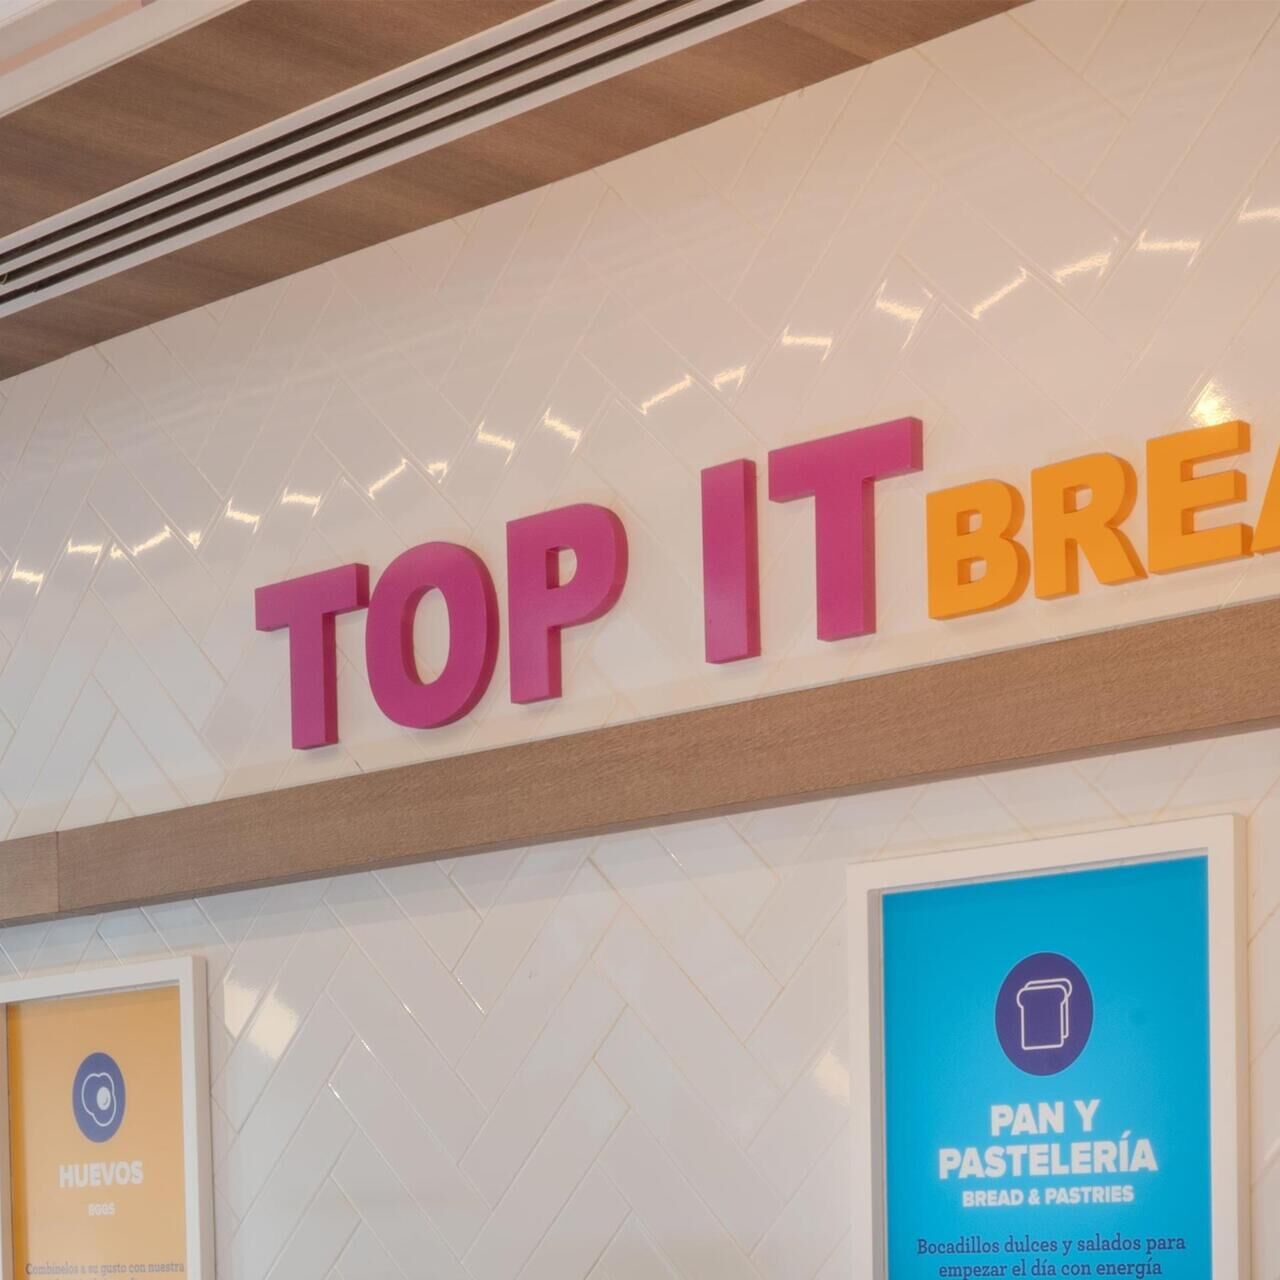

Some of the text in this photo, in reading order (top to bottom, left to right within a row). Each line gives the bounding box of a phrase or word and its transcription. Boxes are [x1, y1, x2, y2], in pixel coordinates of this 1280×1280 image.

[254, 503, 629, 750] TOP
[700, 416, 924, 665] IT
[991, 1099, 1101, 1137] PAN Y
[938, 1131, 1159, 1180] PASTELERÍA
[59, 1160, 144, 1188] HUEVOS
[962, 1185, 1135, 1207] BREAD & PASTRIES
[88, 1202, 115, 1216] EGGS
[917, 1233, 1186, 1256] Bocadillos dulces y salados para
[939, 1257, 1162, 1280] empezar el día con energía
